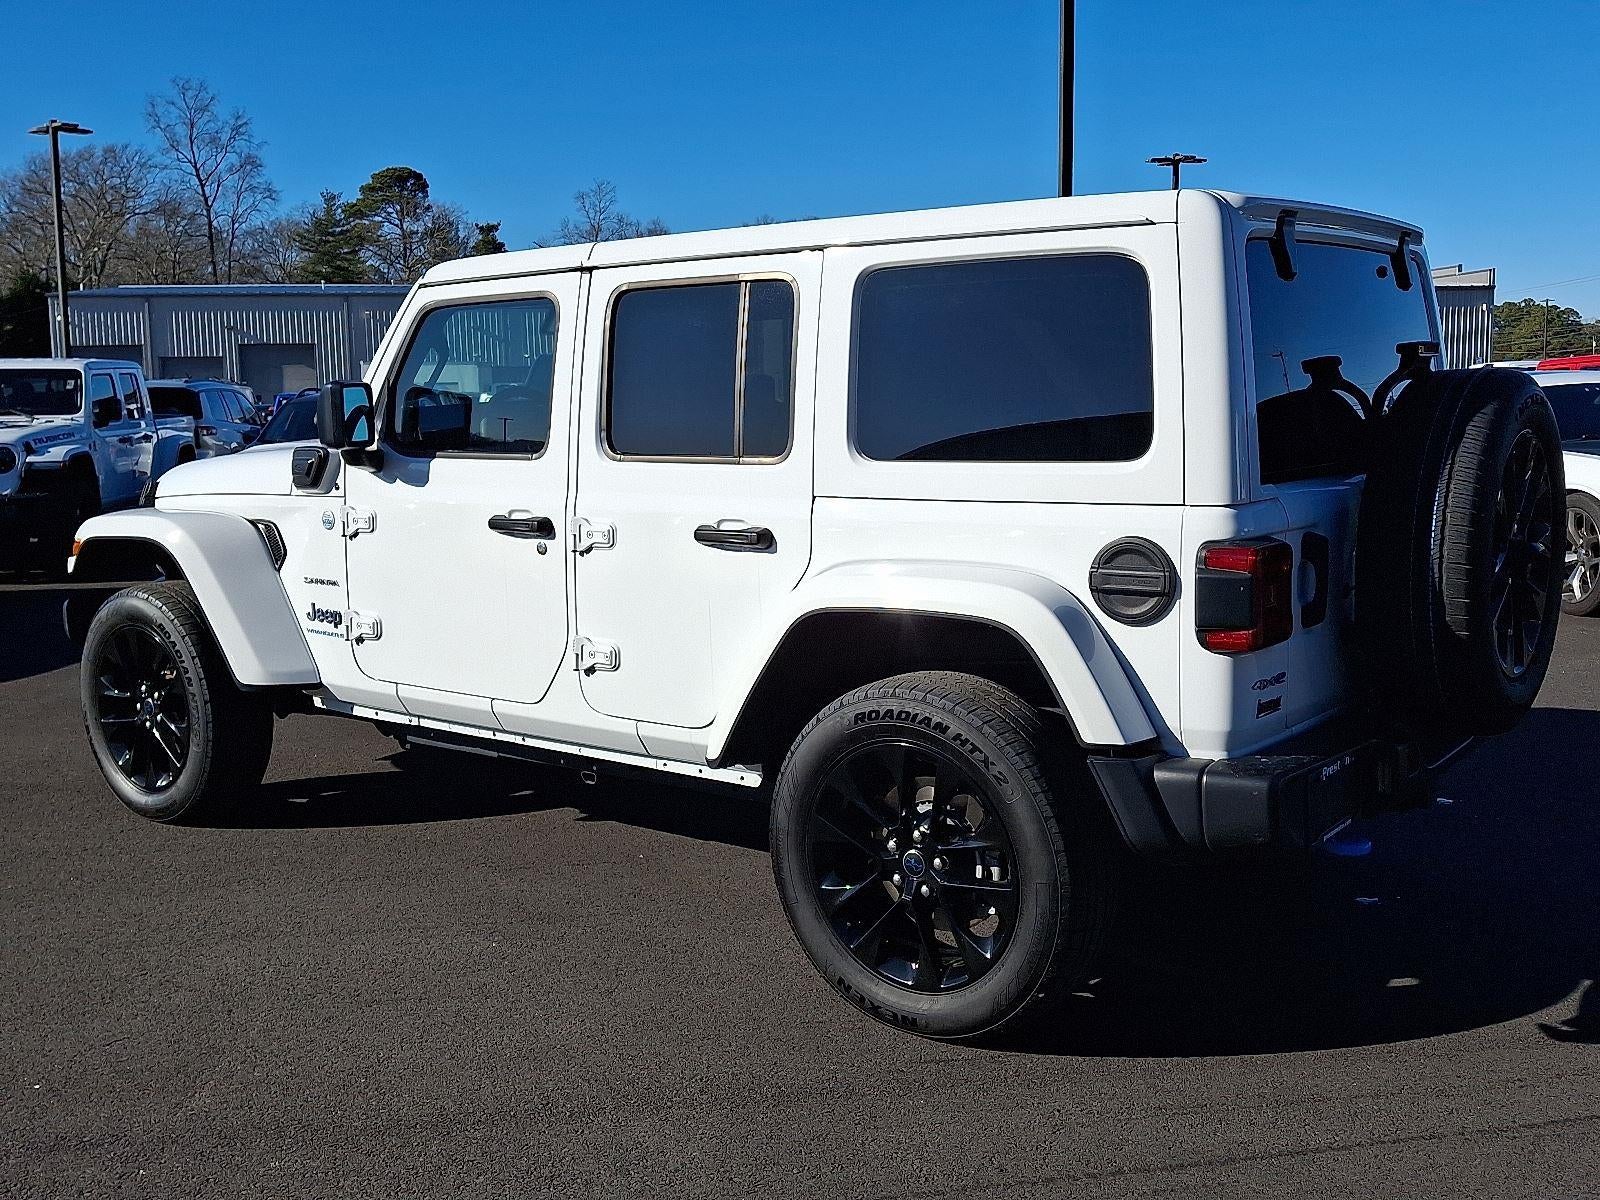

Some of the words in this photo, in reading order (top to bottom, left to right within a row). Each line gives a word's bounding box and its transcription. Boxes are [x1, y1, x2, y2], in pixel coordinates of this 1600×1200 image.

[306, 602, 343, 629] Jeep
[853, 708, 952, 736] ROADIAN
[950, 732, 997, 772] HTX
[990, 769, 1010, 787] 2
[1322, 756, 1350, 780] Prestn
